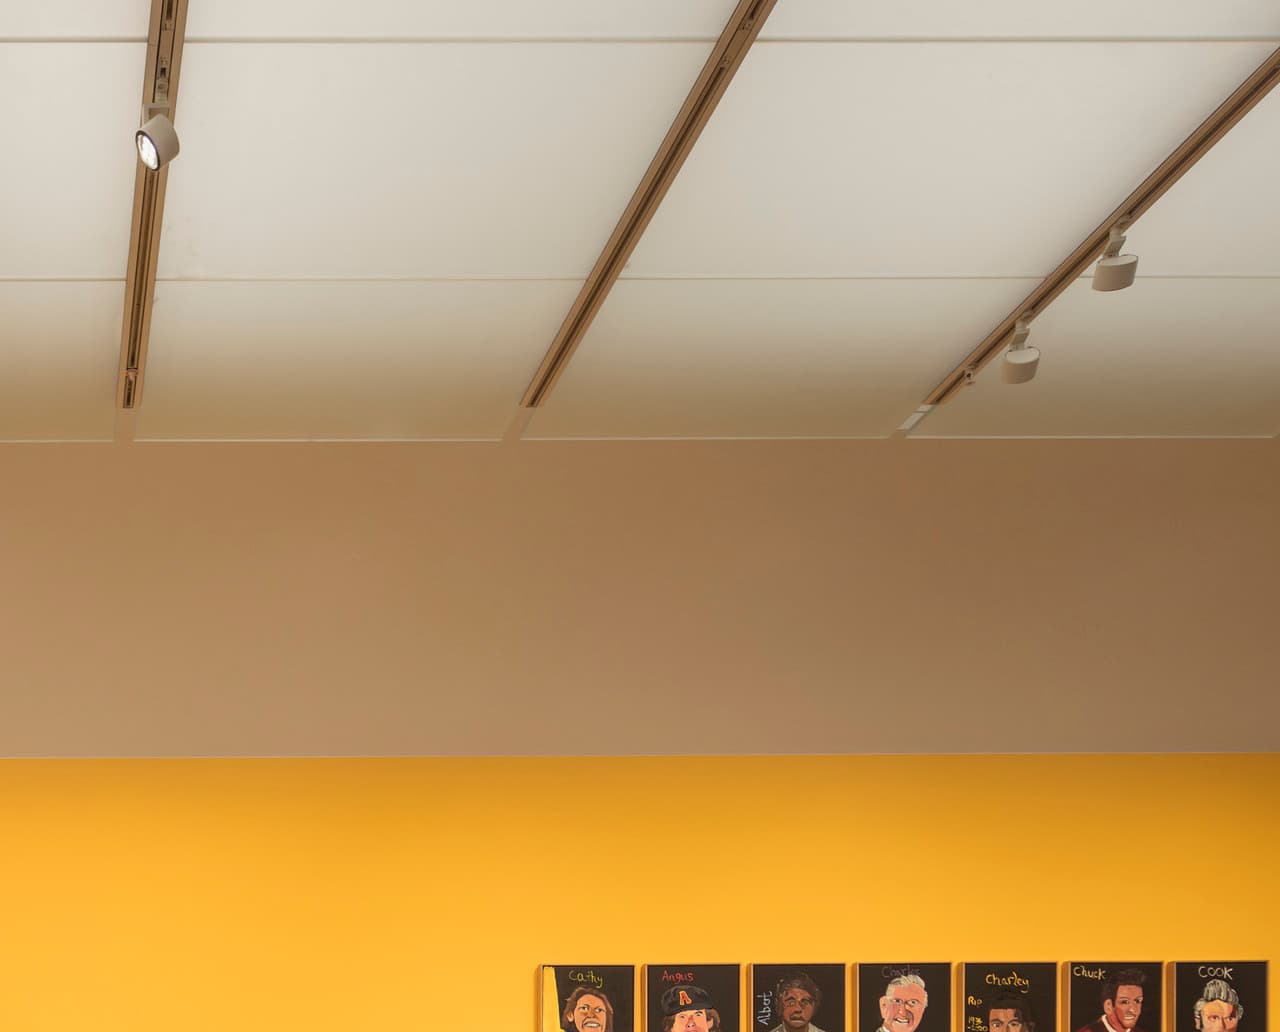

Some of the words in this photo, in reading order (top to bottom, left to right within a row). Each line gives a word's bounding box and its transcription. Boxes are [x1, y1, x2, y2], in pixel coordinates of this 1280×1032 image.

[568, 970, 603, 988] Cathy
[662, 970, 694, 982] Angus
[1073, 965, 1106, 980] Chuck
[1198, 966, 1234, 980] COOK
[985, 972, 1030, 993] Charley
[756, 991, 773, 1025] Albert
